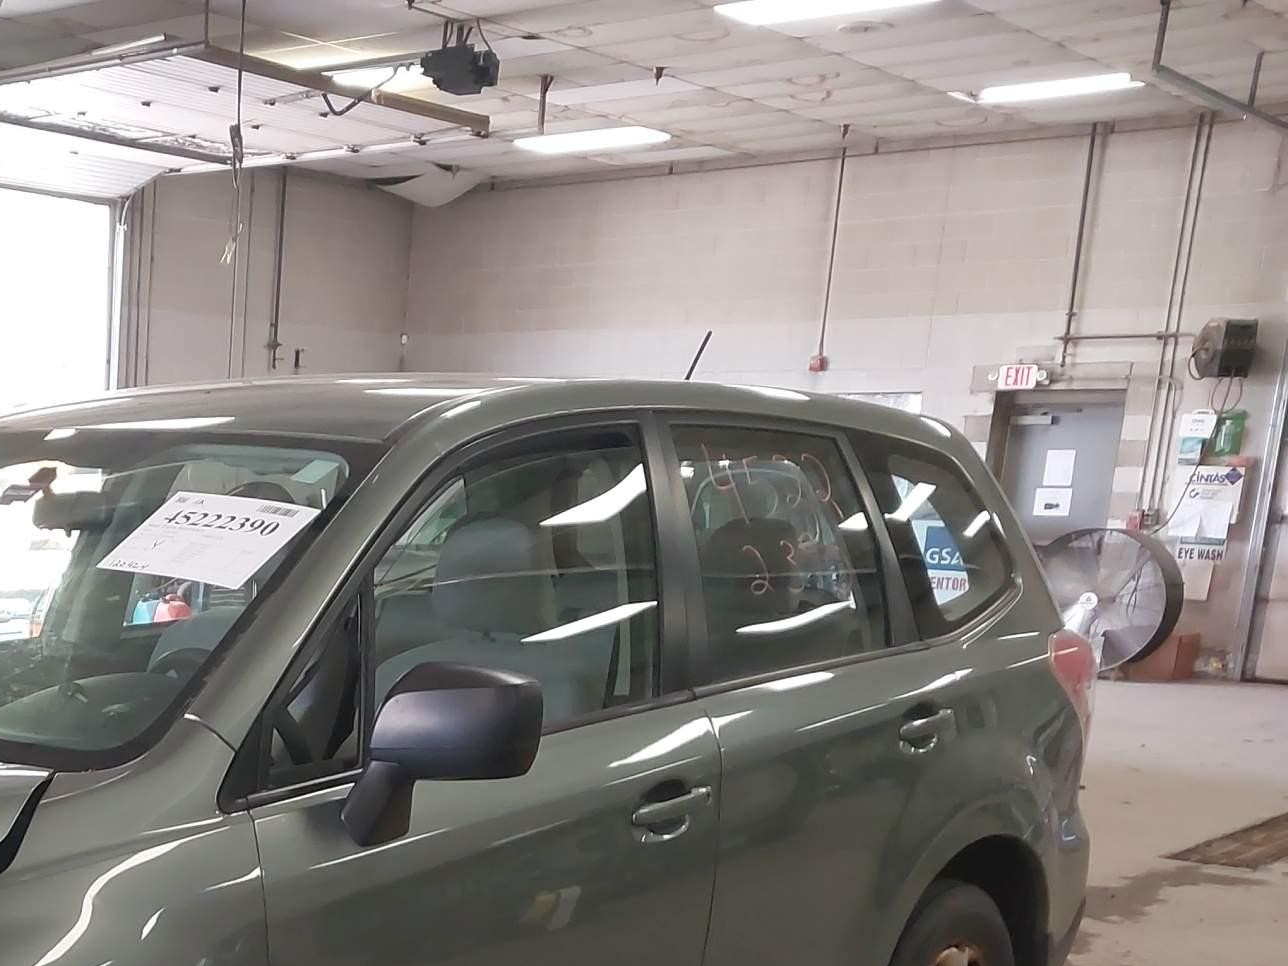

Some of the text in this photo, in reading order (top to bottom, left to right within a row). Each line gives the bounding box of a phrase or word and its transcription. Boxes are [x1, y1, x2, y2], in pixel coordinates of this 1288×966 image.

[1005, 366, 1033, 386] EXIT
[164, 509, 280, 537] 45222390
[925, 547, 964, 566] GSA
[1177, 547, 1224, 560] EYE WASH
